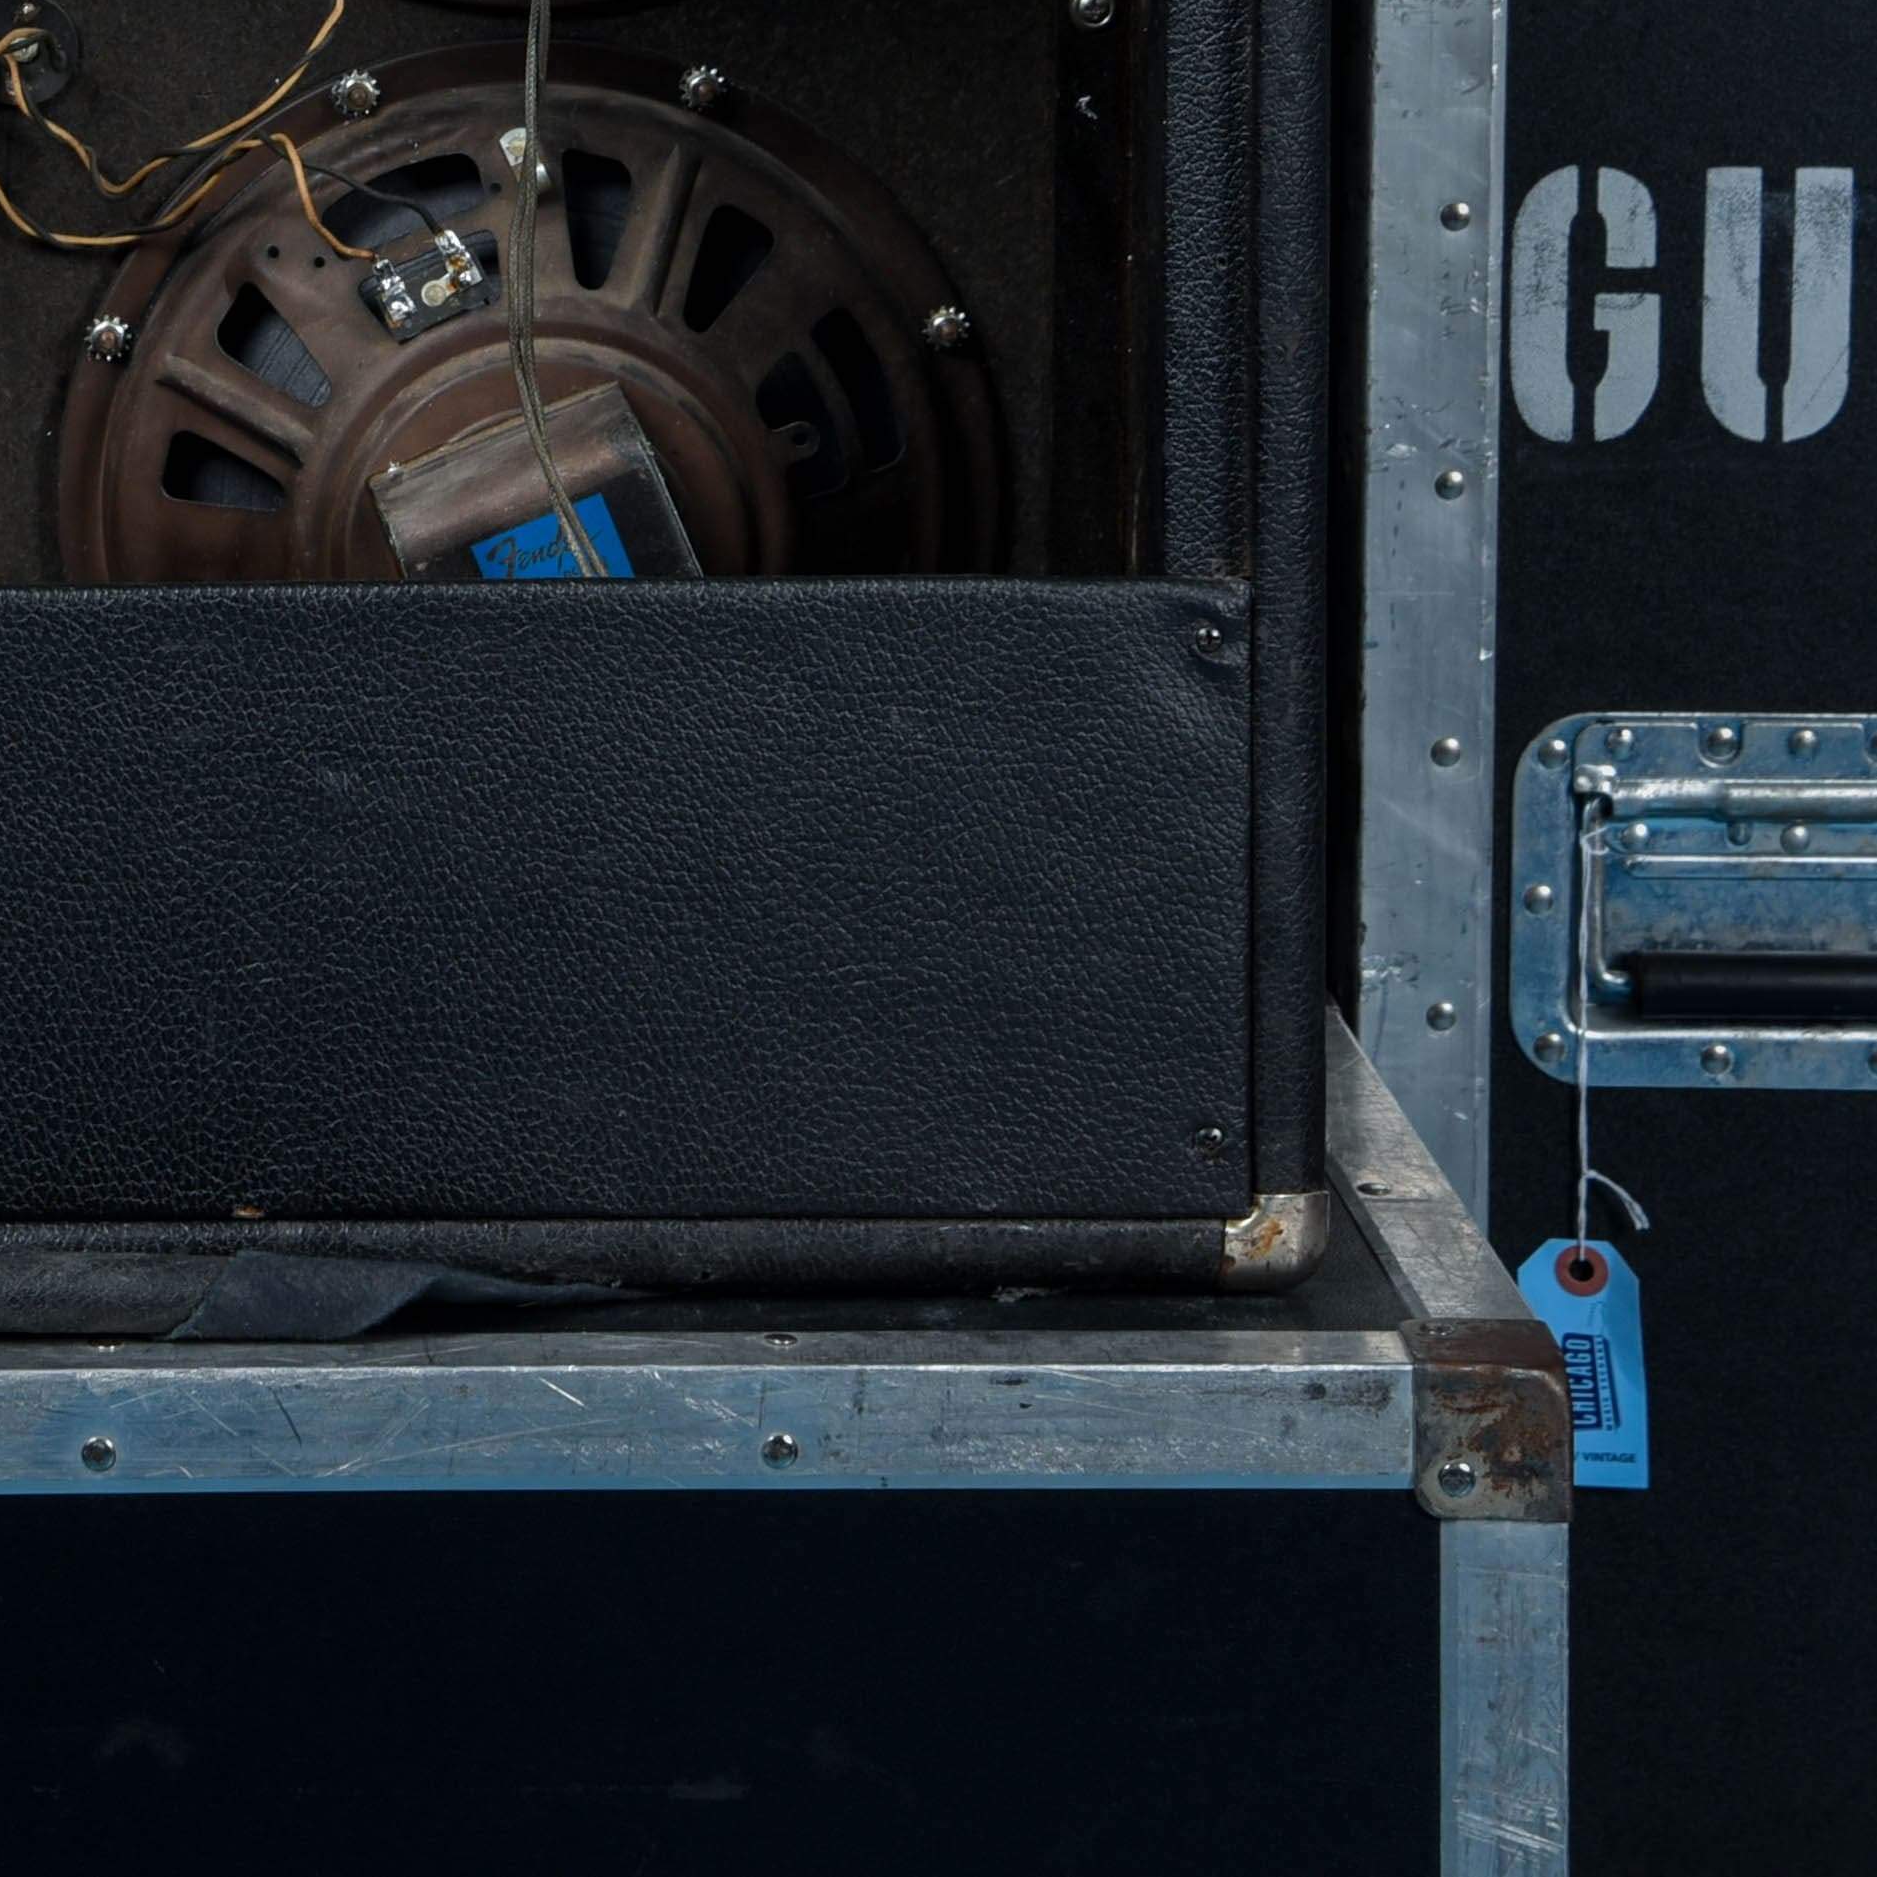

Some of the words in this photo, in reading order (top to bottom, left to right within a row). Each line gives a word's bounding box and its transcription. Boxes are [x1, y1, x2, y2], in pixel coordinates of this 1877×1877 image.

[1510, 164, 1854, 443] GU
[1564, 1338, 1597, 1426] CHICAGO
[1582, 1451, 1636, 1464] VINTAGE
